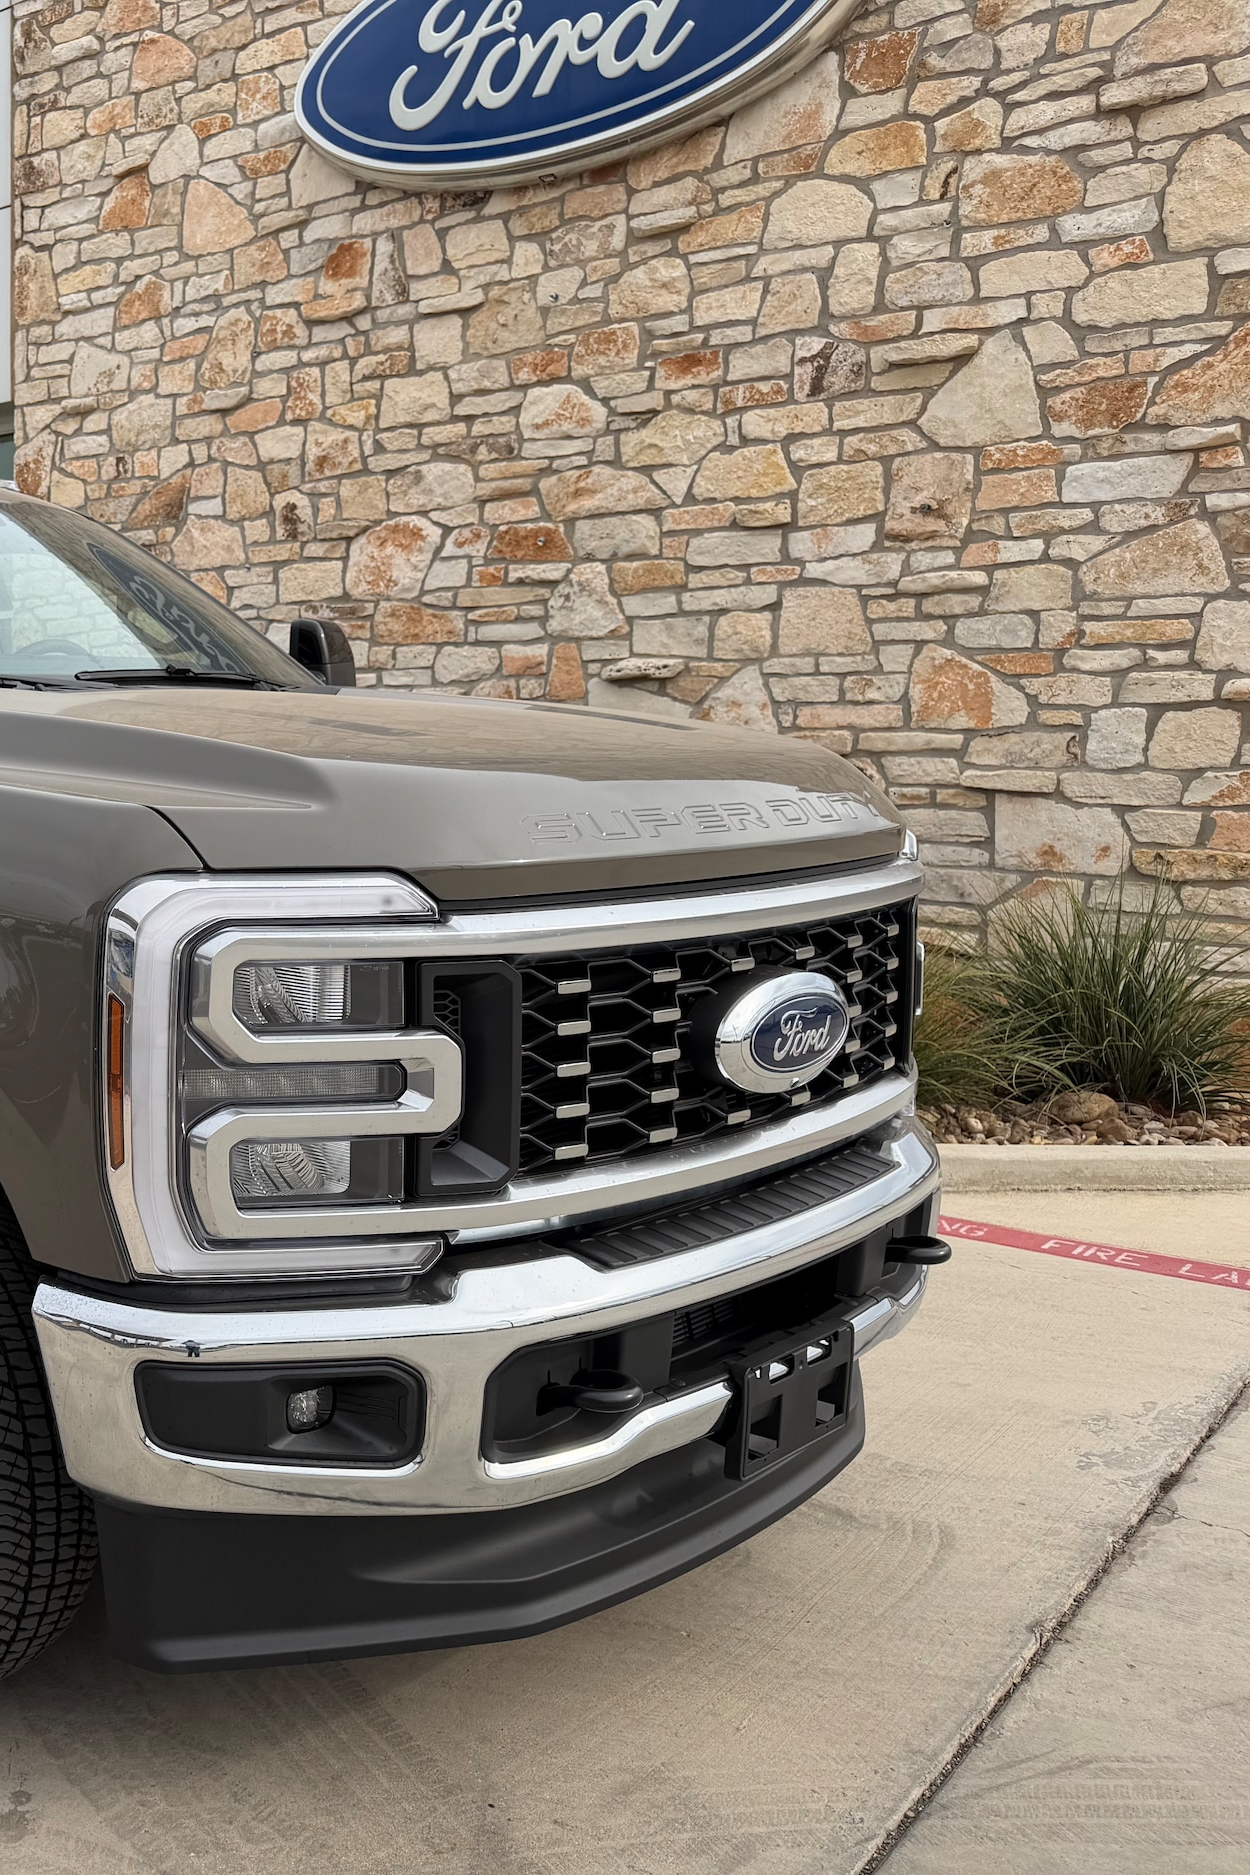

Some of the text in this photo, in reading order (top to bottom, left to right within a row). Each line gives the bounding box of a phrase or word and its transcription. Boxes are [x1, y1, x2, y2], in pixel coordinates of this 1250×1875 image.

[389, 0, 696, 131] Ford
[520, 789, 881, 845] SUPER DUTY
[773, 1007, 832, 1061] Ford
[937, 1219, 1250, 1286] NG FIRE LA
